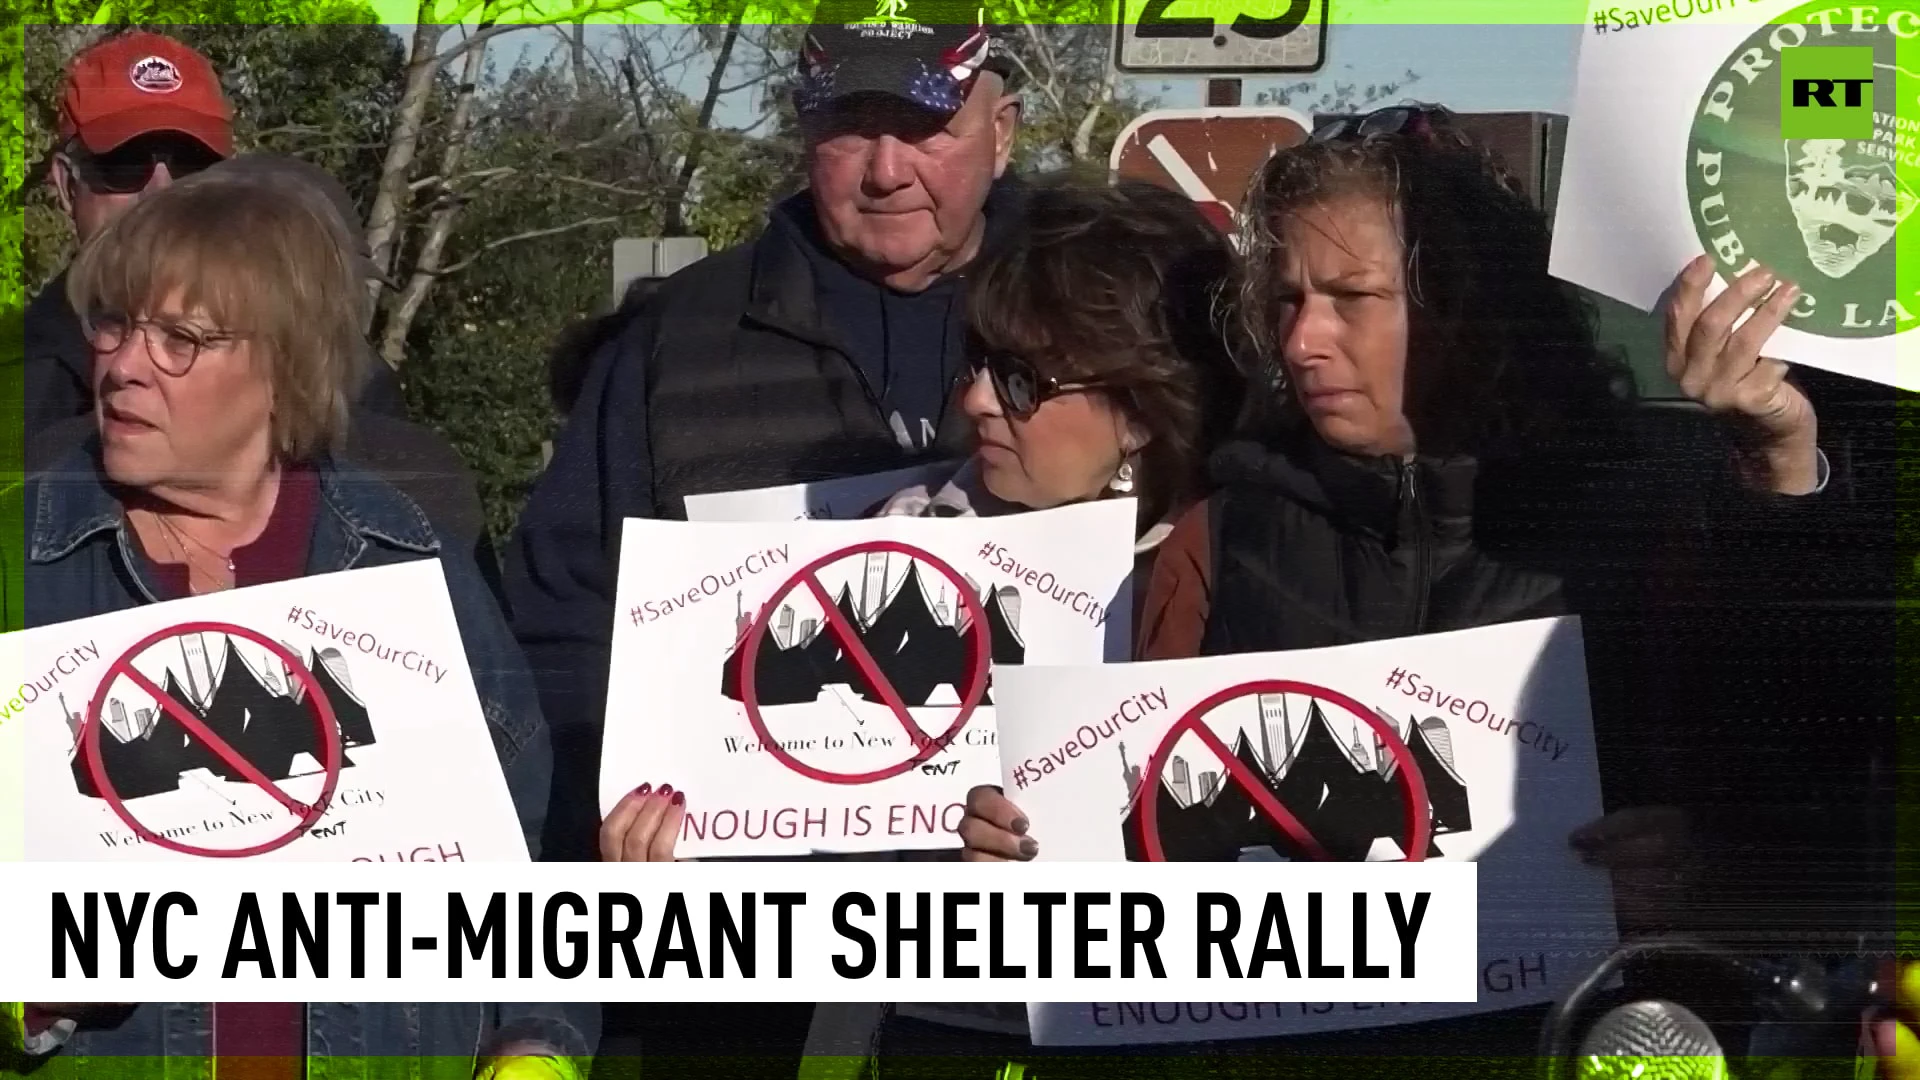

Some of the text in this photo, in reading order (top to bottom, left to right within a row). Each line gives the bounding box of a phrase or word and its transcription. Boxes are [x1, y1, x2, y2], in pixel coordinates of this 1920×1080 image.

[1873, 128, 1916, 150] PARK
[1841, 290, 1920, 328] LA
[631, 543, 789, 627] #SaveOurCity
[978, 541, 1111, 628] #SaveOurCity
[0, 639, 100, 725] veOurCity
[287, 605, 448, 684] #SaveOurCity
[723, 735, 817, 753] Welcome
[824, 735, 844, 750] to
[851, 731, 896, 748] New
[965, 728, 997, 749] Cit
[1012, 686, 1168, 790] #SaveOurCity
[1385, 667, 1569, 760] #SaveOurCity
[98, 824, 197, 848] Welcome
[203, 819, 224, 832] to
[228, 810, 274, 828] New
[340, 788, 385, 808] City
[683, 803, 968, 841] NOUGH IS ENO
